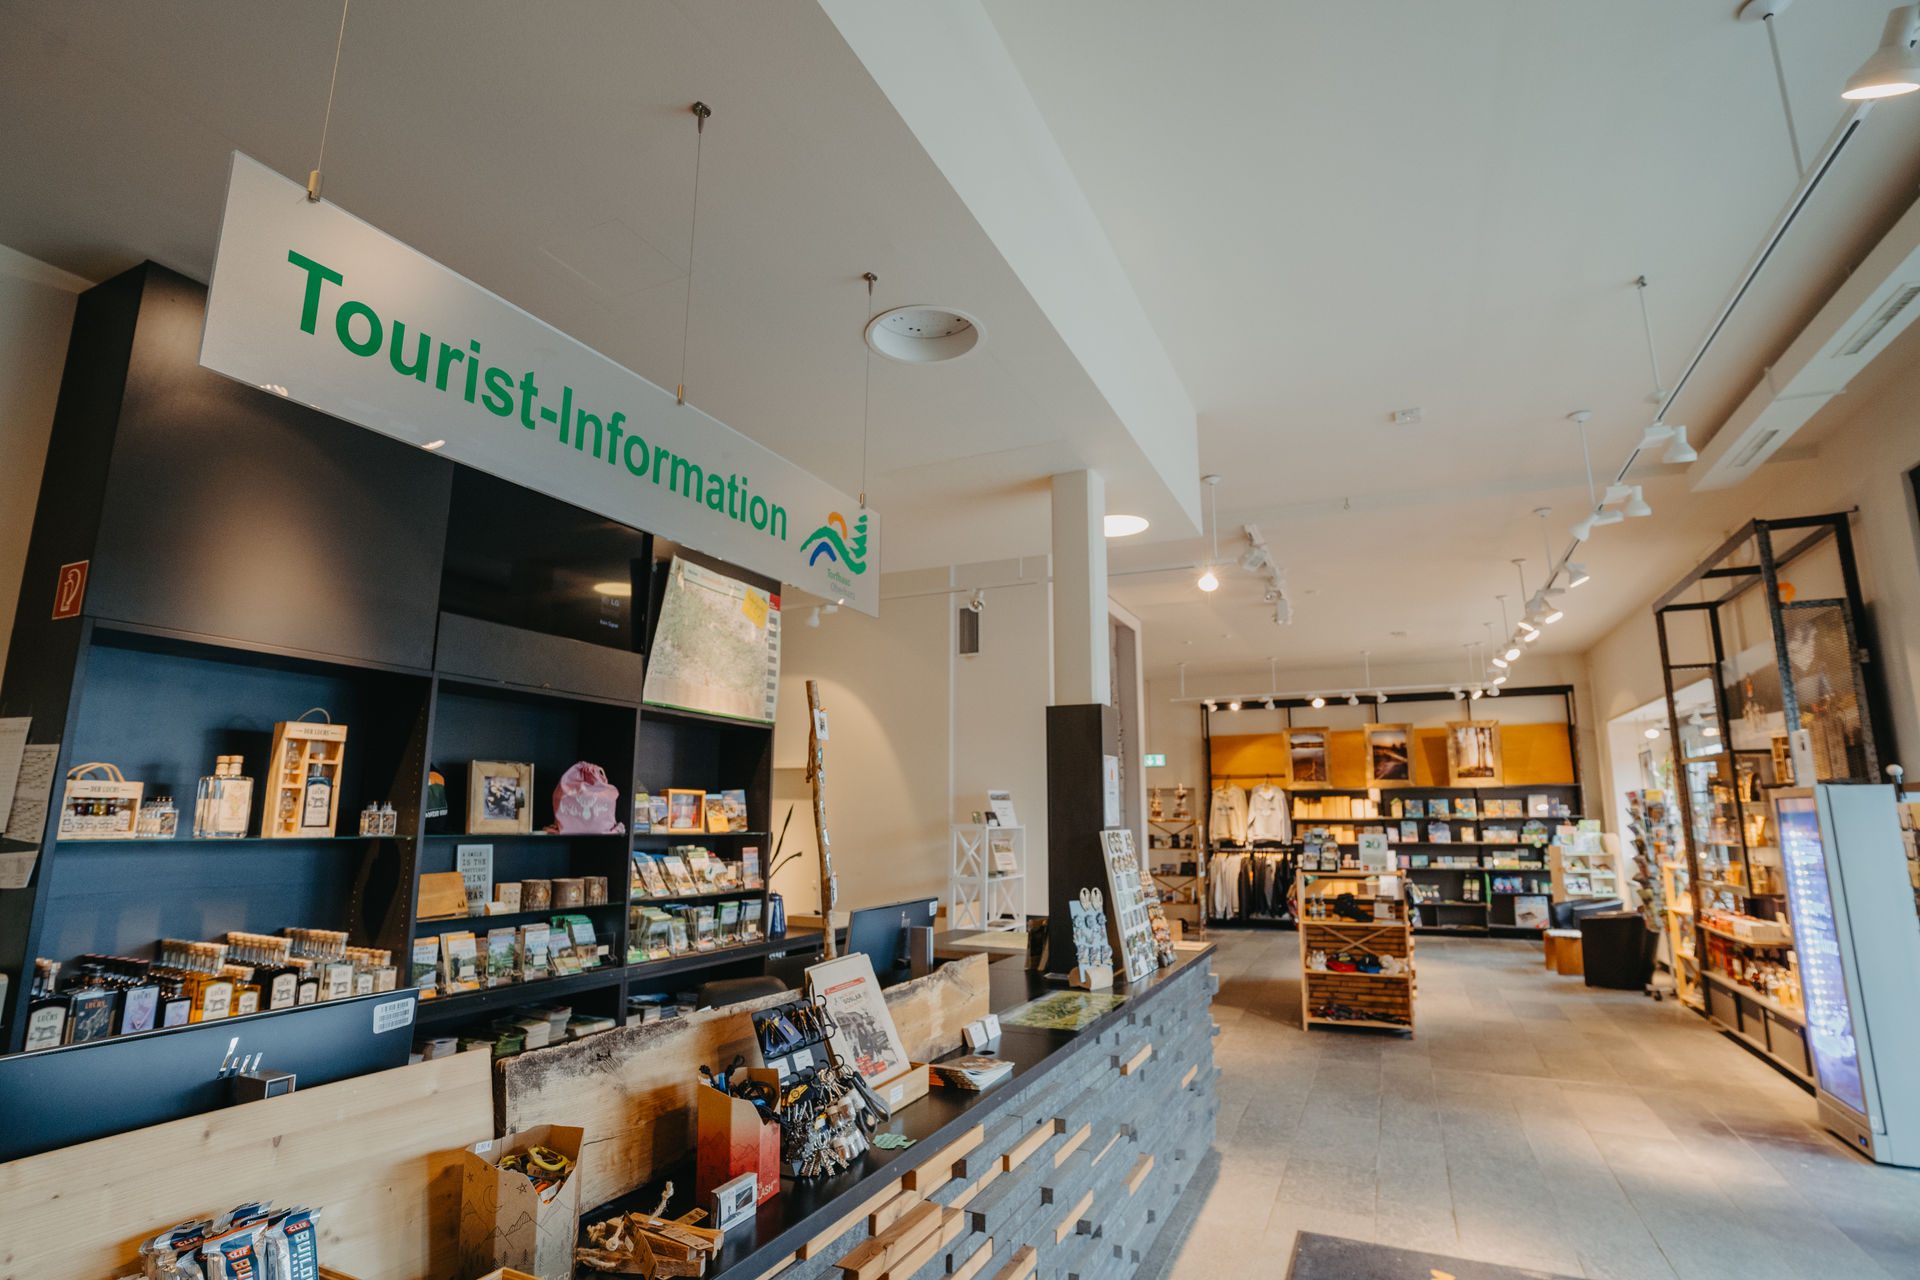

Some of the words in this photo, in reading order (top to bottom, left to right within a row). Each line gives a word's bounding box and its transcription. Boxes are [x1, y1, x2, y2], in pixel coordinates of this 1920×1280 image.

[288, 249, 787, 541] Tourist-Information
[289, 1221, 309, 1232] CLIF
[227, 1245, 250, 1260] CLIF
[294, 1230, 314, 1280] BUILD
